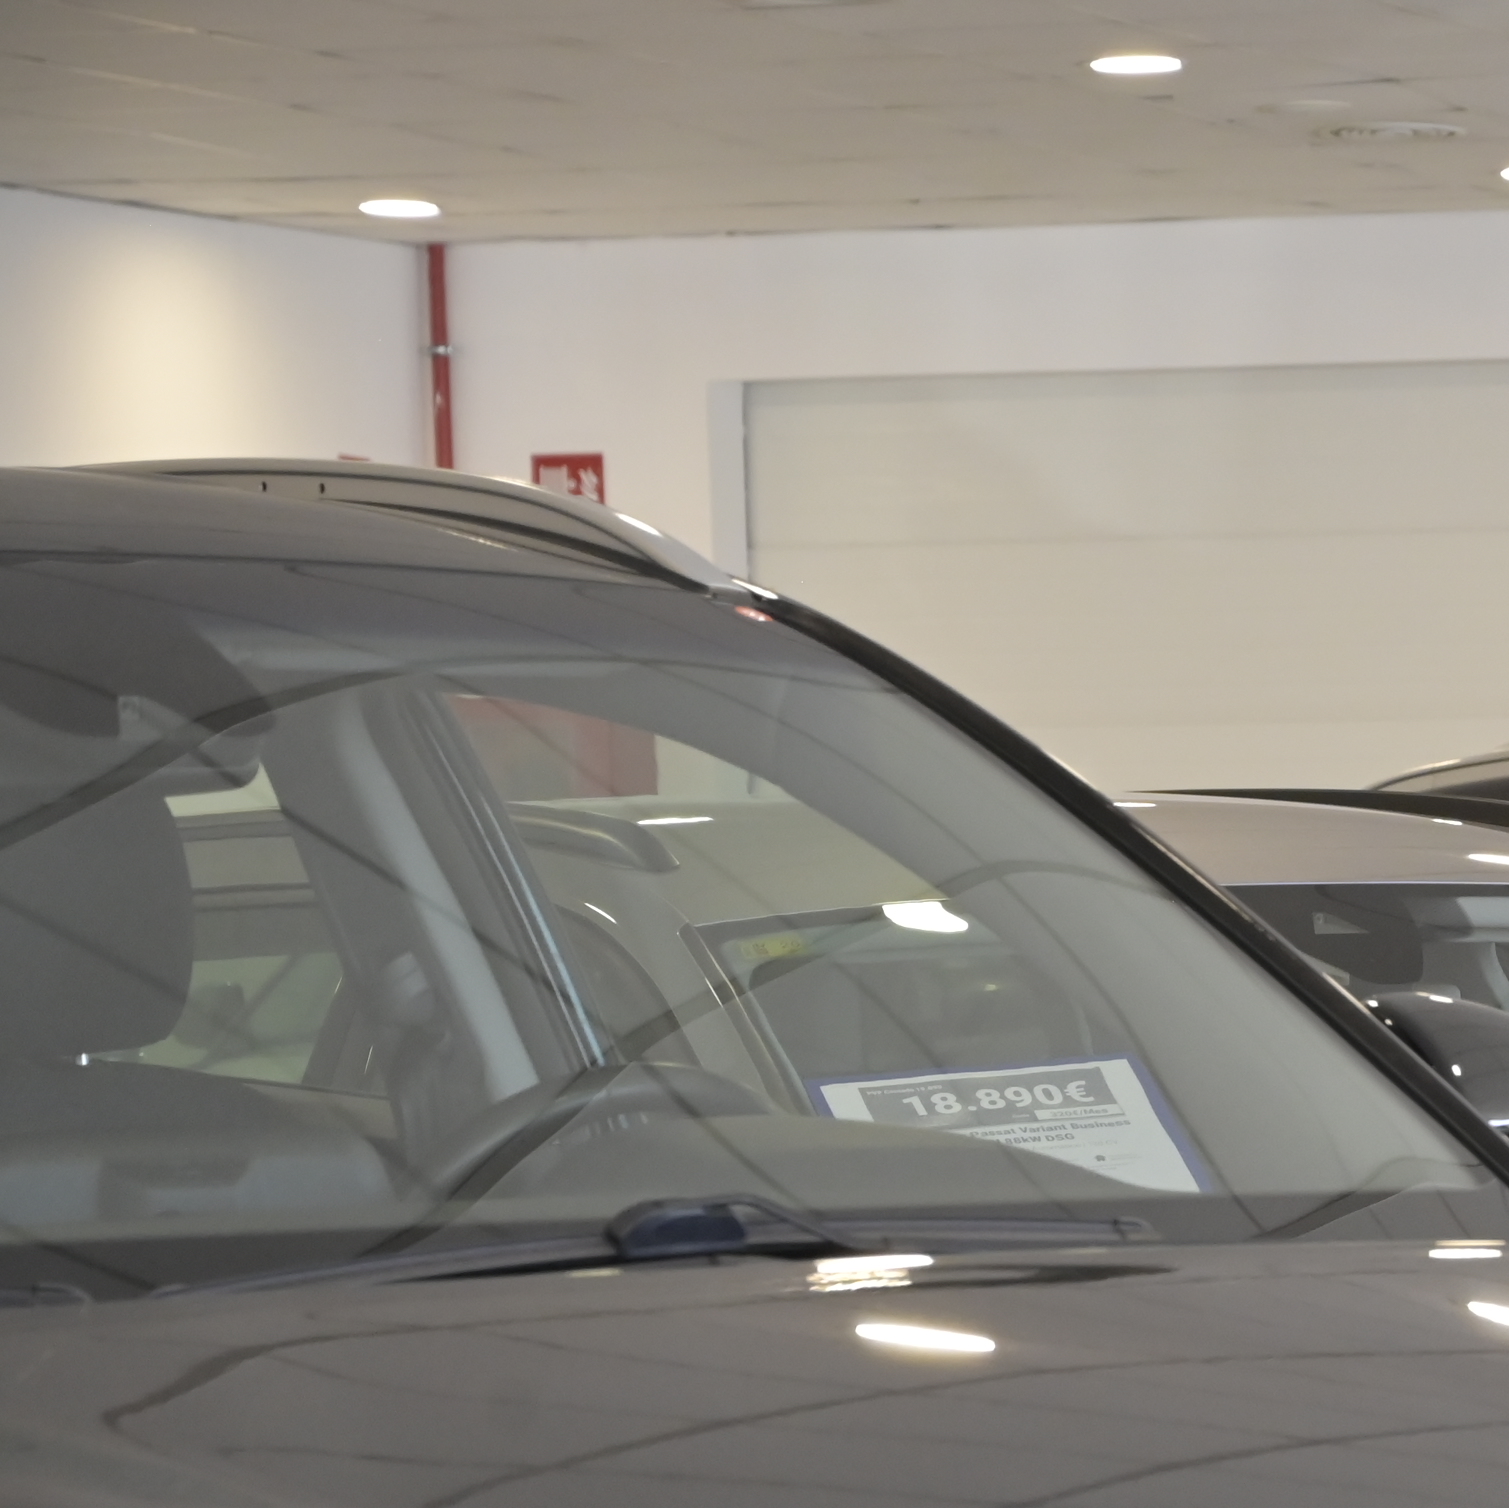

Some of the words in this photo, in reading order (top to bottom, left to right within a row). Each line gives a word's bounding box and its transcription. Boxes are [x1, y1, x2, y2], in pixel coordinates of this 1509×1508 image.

[902, 1080, 1094, 1116] 18.890€
[1018, 1123, 1067, 1135] Variant
[1070, 1118, 1132, 1131] Business
[1045, 1132, 1076, 1143] DSG
